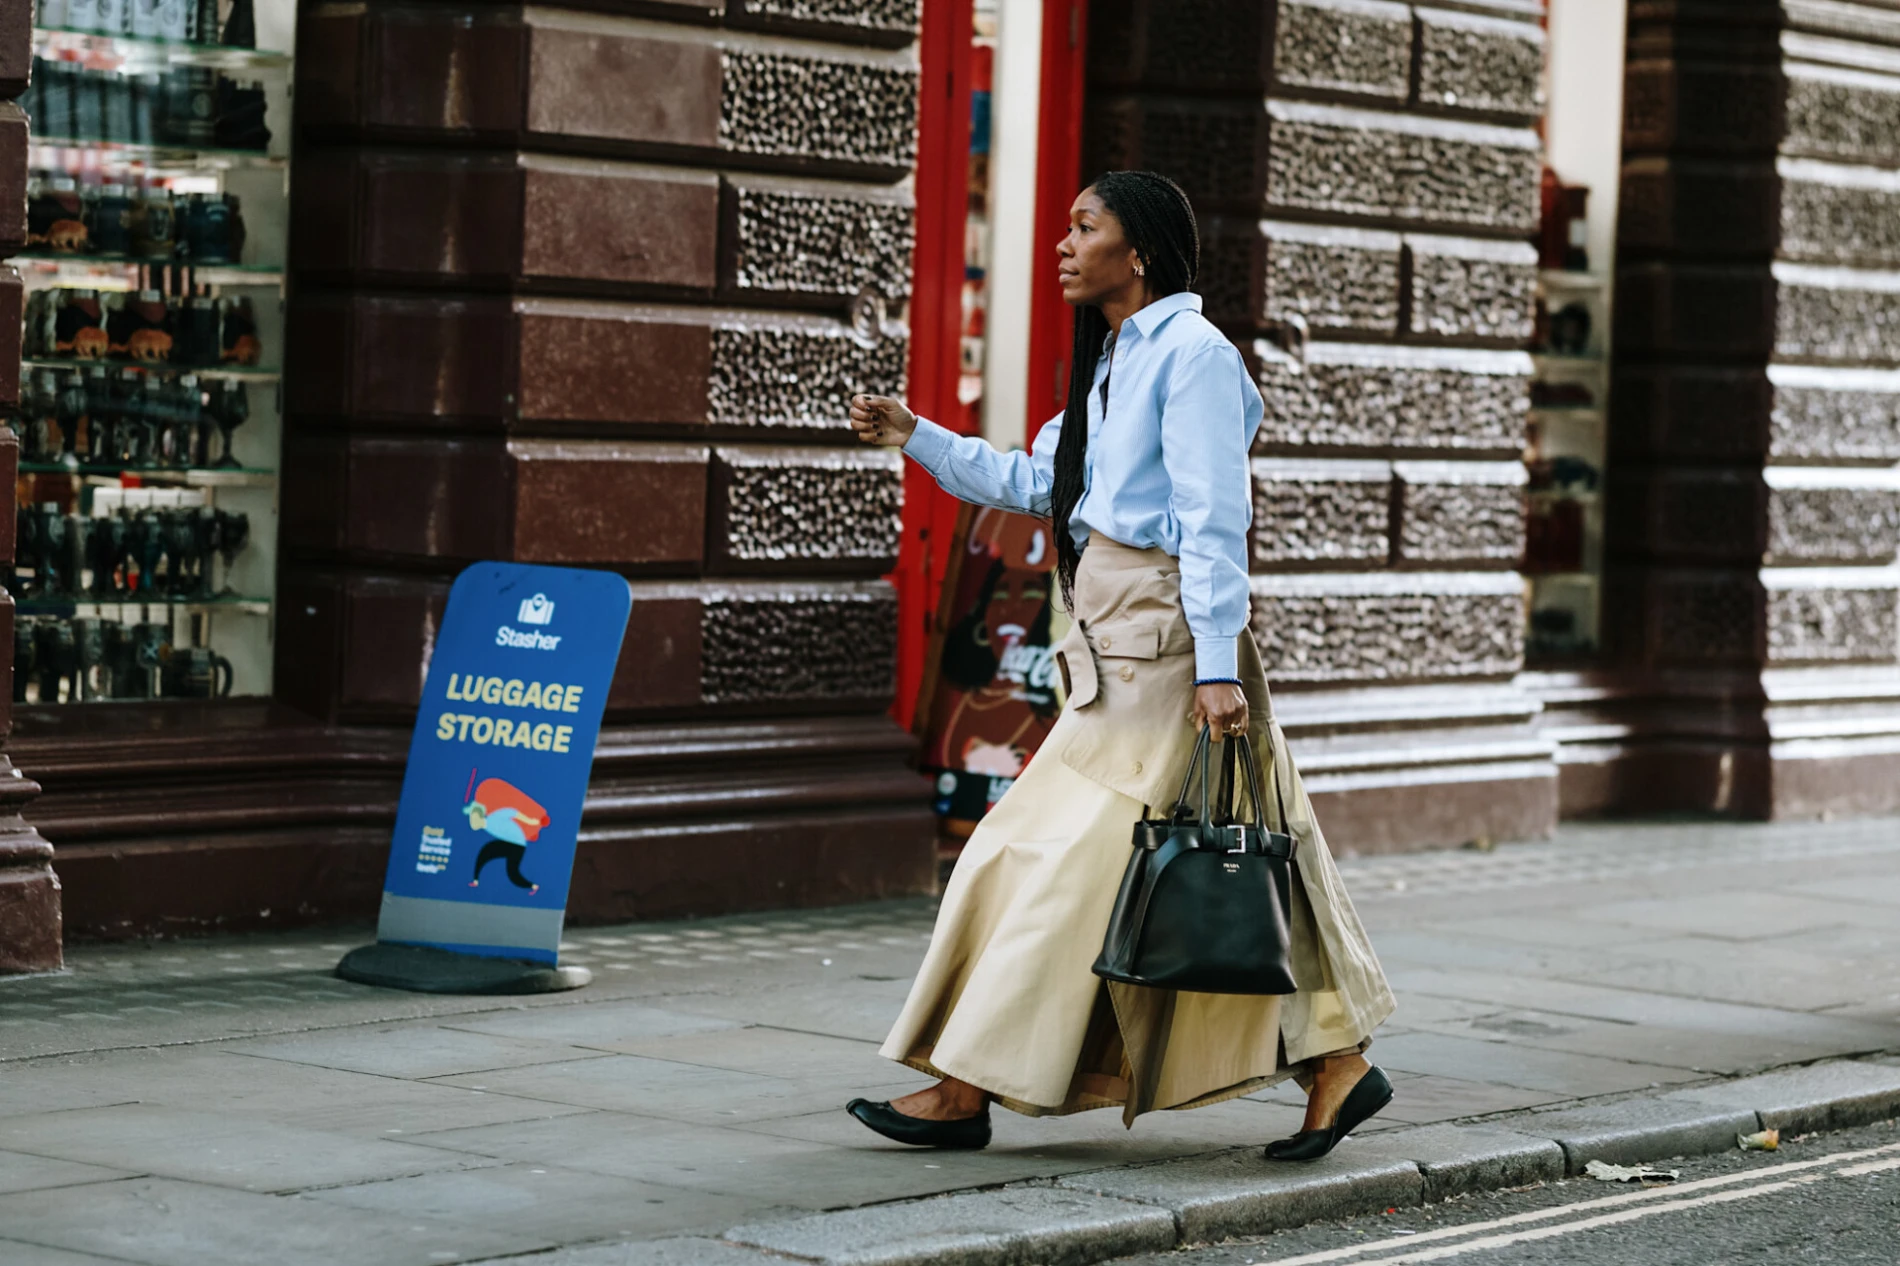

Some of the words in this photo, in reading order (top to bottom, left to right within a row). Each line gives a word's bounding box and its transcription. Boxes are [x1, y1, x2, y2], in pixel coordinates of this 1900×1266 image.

[495, 625, 562, 651] Stasher
[446, 673, 584, 713] LUGGAGE
[436, 712, 573, 753] STORAGE
